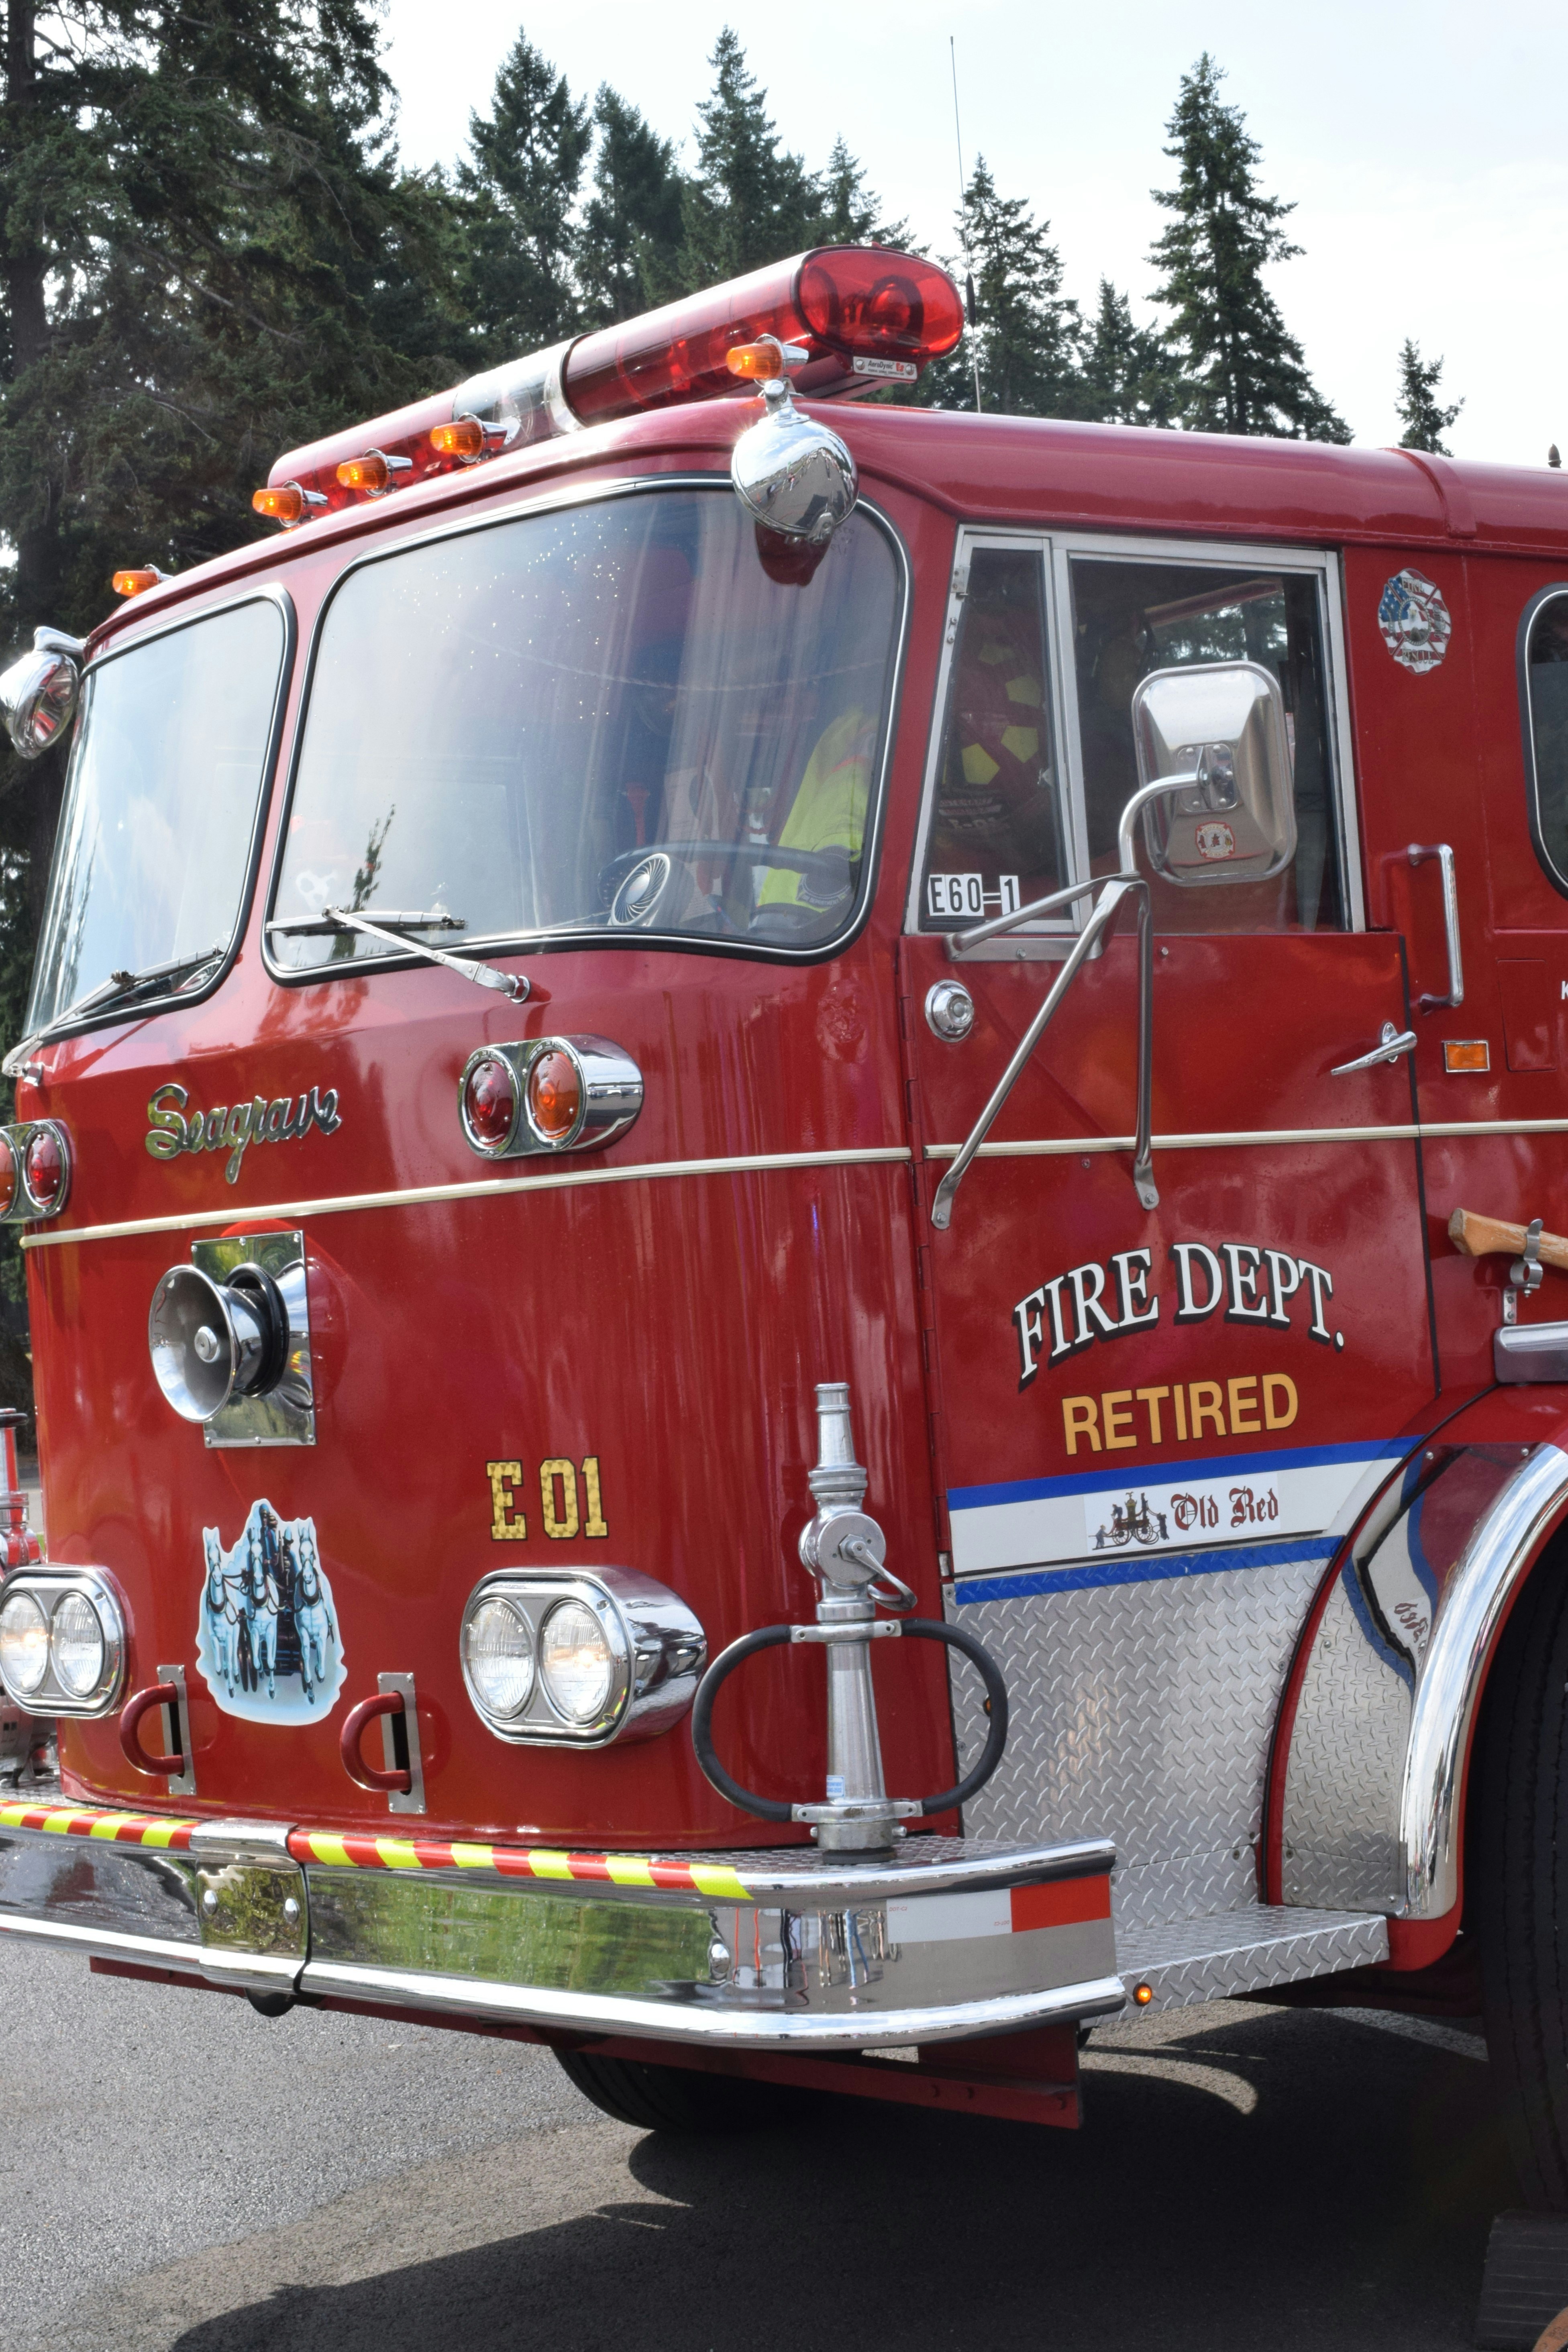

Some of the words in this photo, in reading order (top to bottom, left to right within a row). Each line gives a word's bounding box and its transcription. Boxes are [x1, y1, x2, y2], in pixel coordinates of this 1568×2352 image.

[868, 360, 893, 369] AeroDynic
[930, 877, 1015, 913] E60-1
[145, 1083, 342, 1184] Seagrave
[1013, 1247, 1159, 1391] FIRE
[1168, 1243, 1344, 1352] DEPT.
[1061, 1373, 1299, 1456] RETIRED
[486, 1459, 527, 1541] E
[1170, 1492, 1219, 1531] Old
[1229, 1485, 1279, 1528] Red
